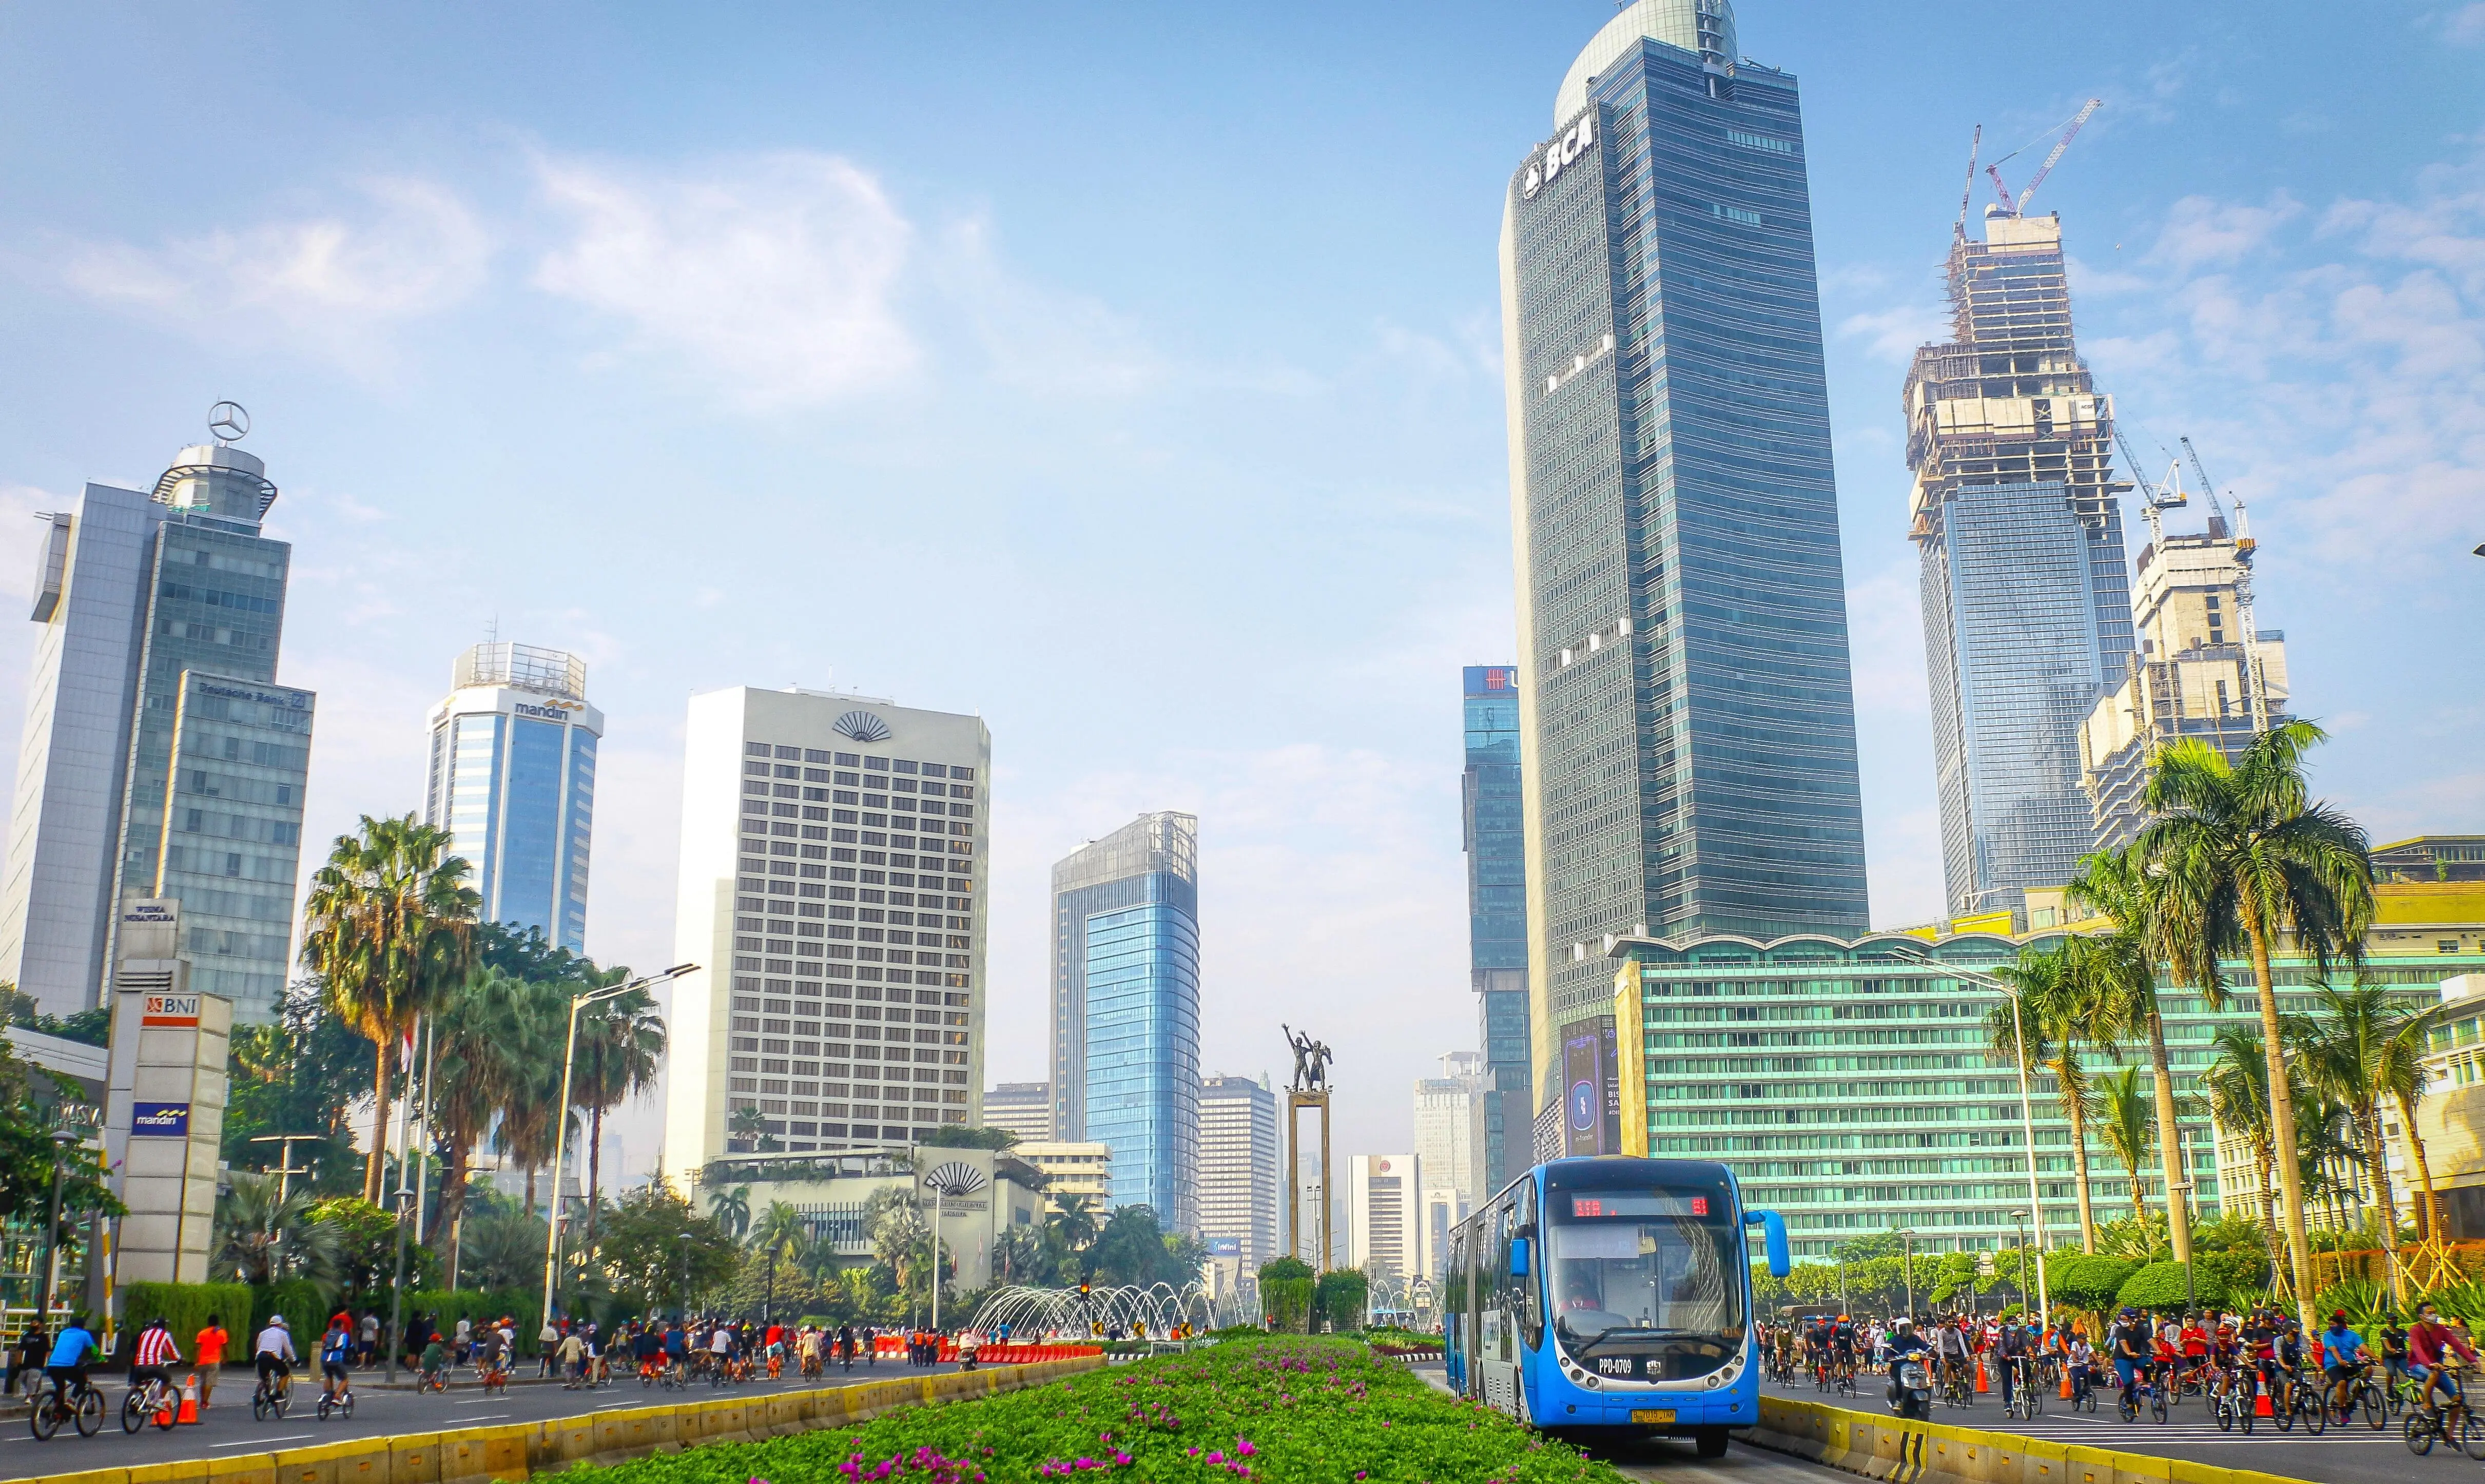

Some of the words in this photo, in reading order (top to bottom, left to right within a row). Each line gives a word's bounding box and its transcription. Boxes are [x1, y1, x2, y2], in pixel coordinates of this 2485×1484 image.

[1545, 113, 1593, 183] BCA
[164, 999, 196, 1013] BNI
[1599, 1358, 1632, 1374] PPD-0709
